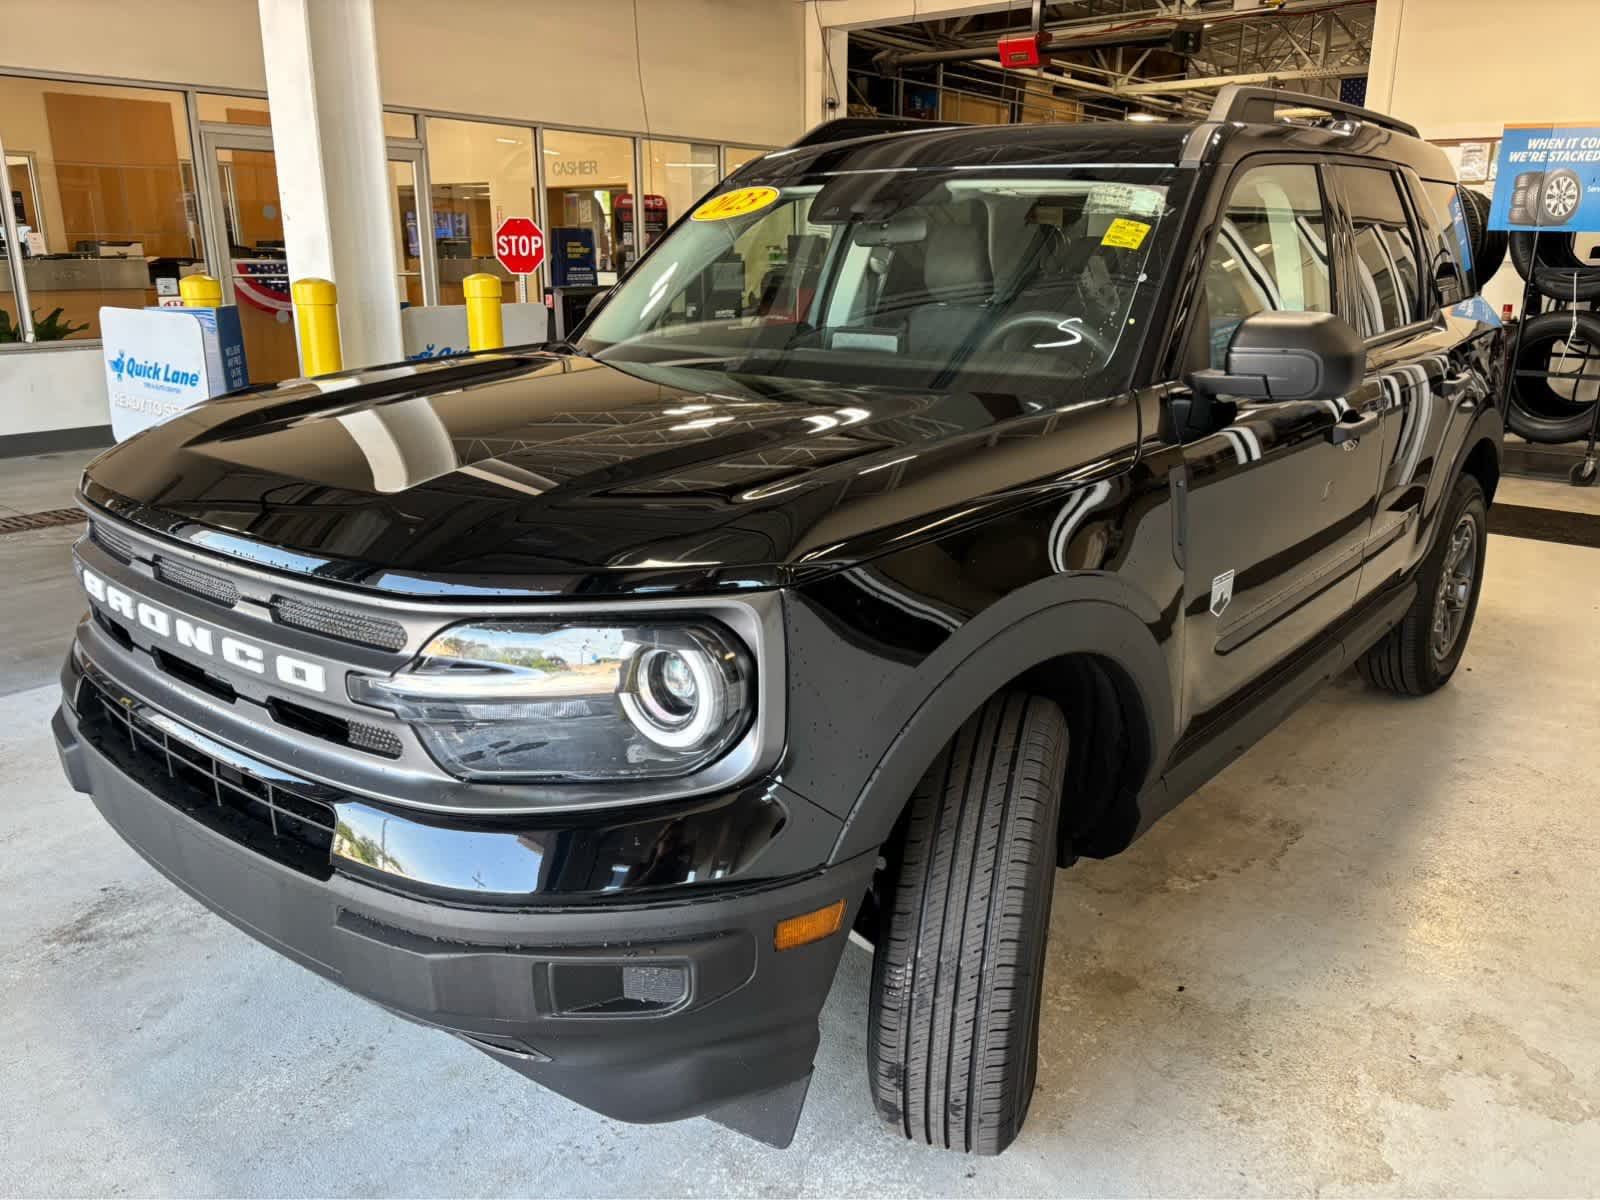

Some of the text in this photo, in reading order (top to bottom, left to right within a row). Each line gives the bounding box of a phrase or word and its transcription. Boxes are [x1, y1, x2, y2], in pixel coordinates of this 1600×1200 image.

[1528, 138, 1565, 150] WHEN
[1566, 138, 1579, 150] IT
[1509, 150, 1600, 163] WE'RE STACKED
[552, 160, 598, 177] CASHIER
[498, 235, 542, 257] STOP
[127, 357, 161, 381] Quick
[163, 364, 199, 387] Lane
[83, 568, 326, 693] BRONCO
